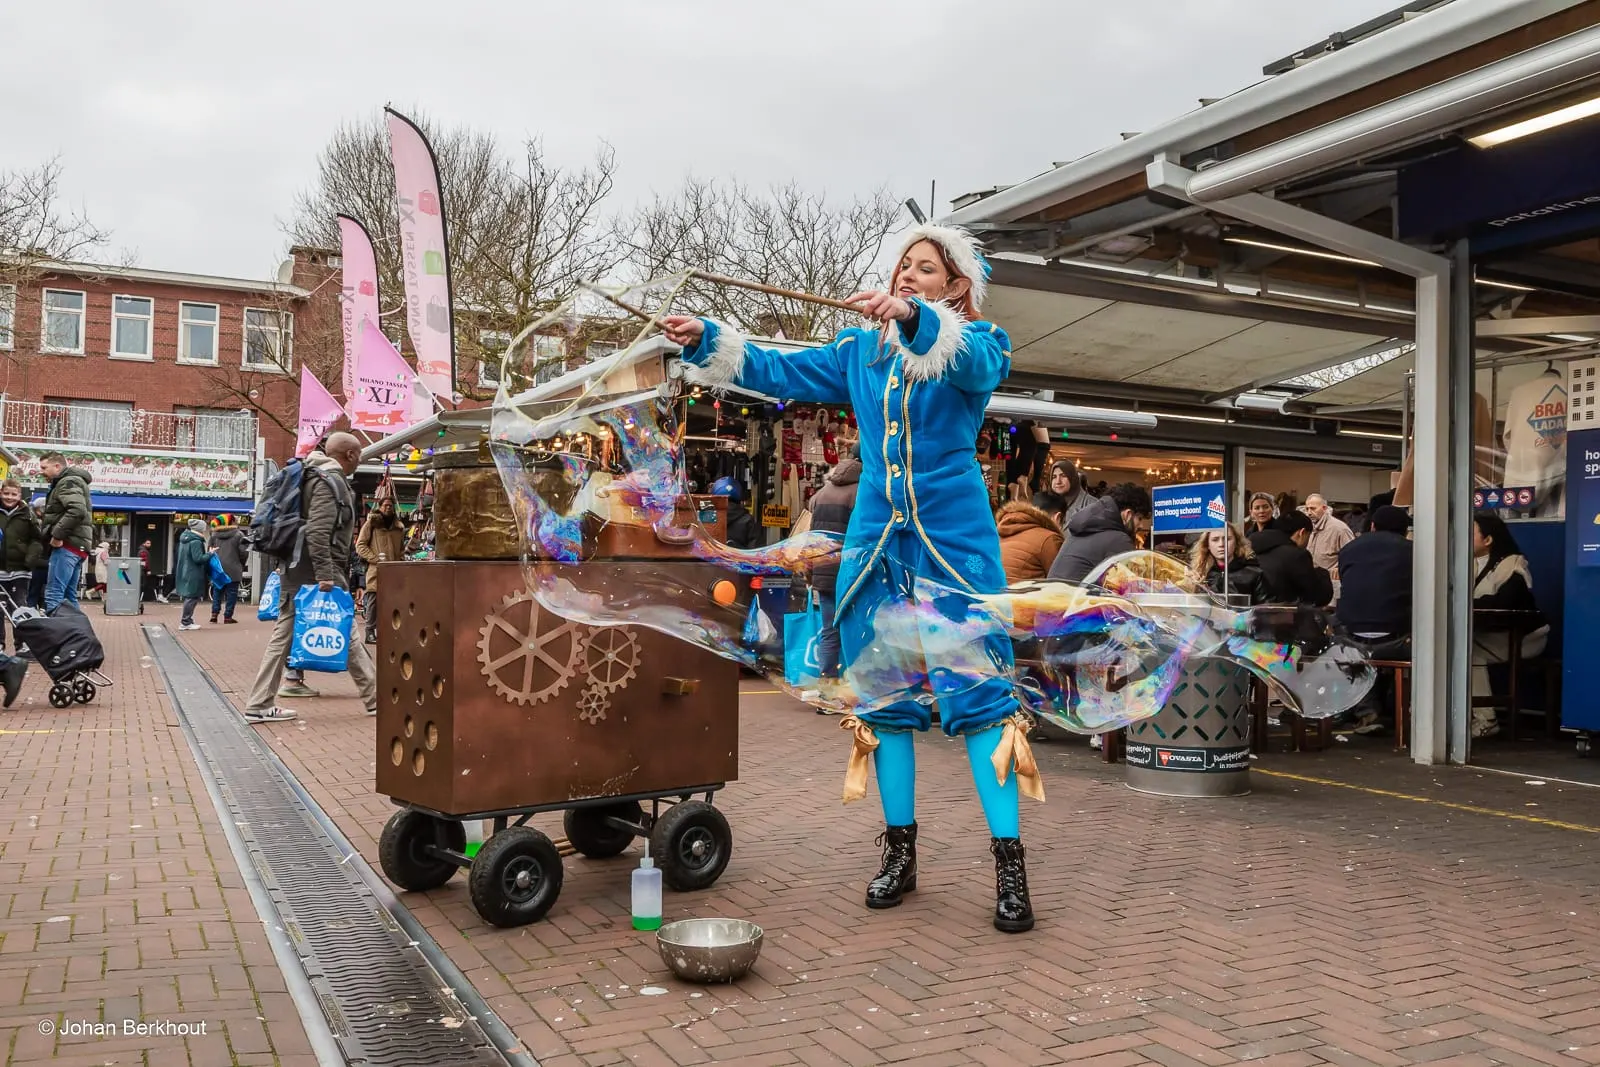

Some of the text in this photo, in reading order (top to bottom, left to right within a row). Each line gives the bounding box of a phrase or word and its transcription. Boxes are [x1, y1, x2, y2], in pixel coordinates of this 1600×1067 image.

[360, 377, 408, 389] MILANO TASSEN
[368, 386, 397, 405] XL
[1534, 419, 1566, 431] LADA
[101, 466, 134, 476] gezond
[1585, 464, 1600, 475] sp
[1173, 496, 1193, 506] houden
[1155, 508, 1165, 517] Den
[1165, 507, 1179, 517] Haag
[312, 599, 338, 610] JACO
[307, 611, 342, 623] JEANS
[305, 633, 342, 650] CARS
